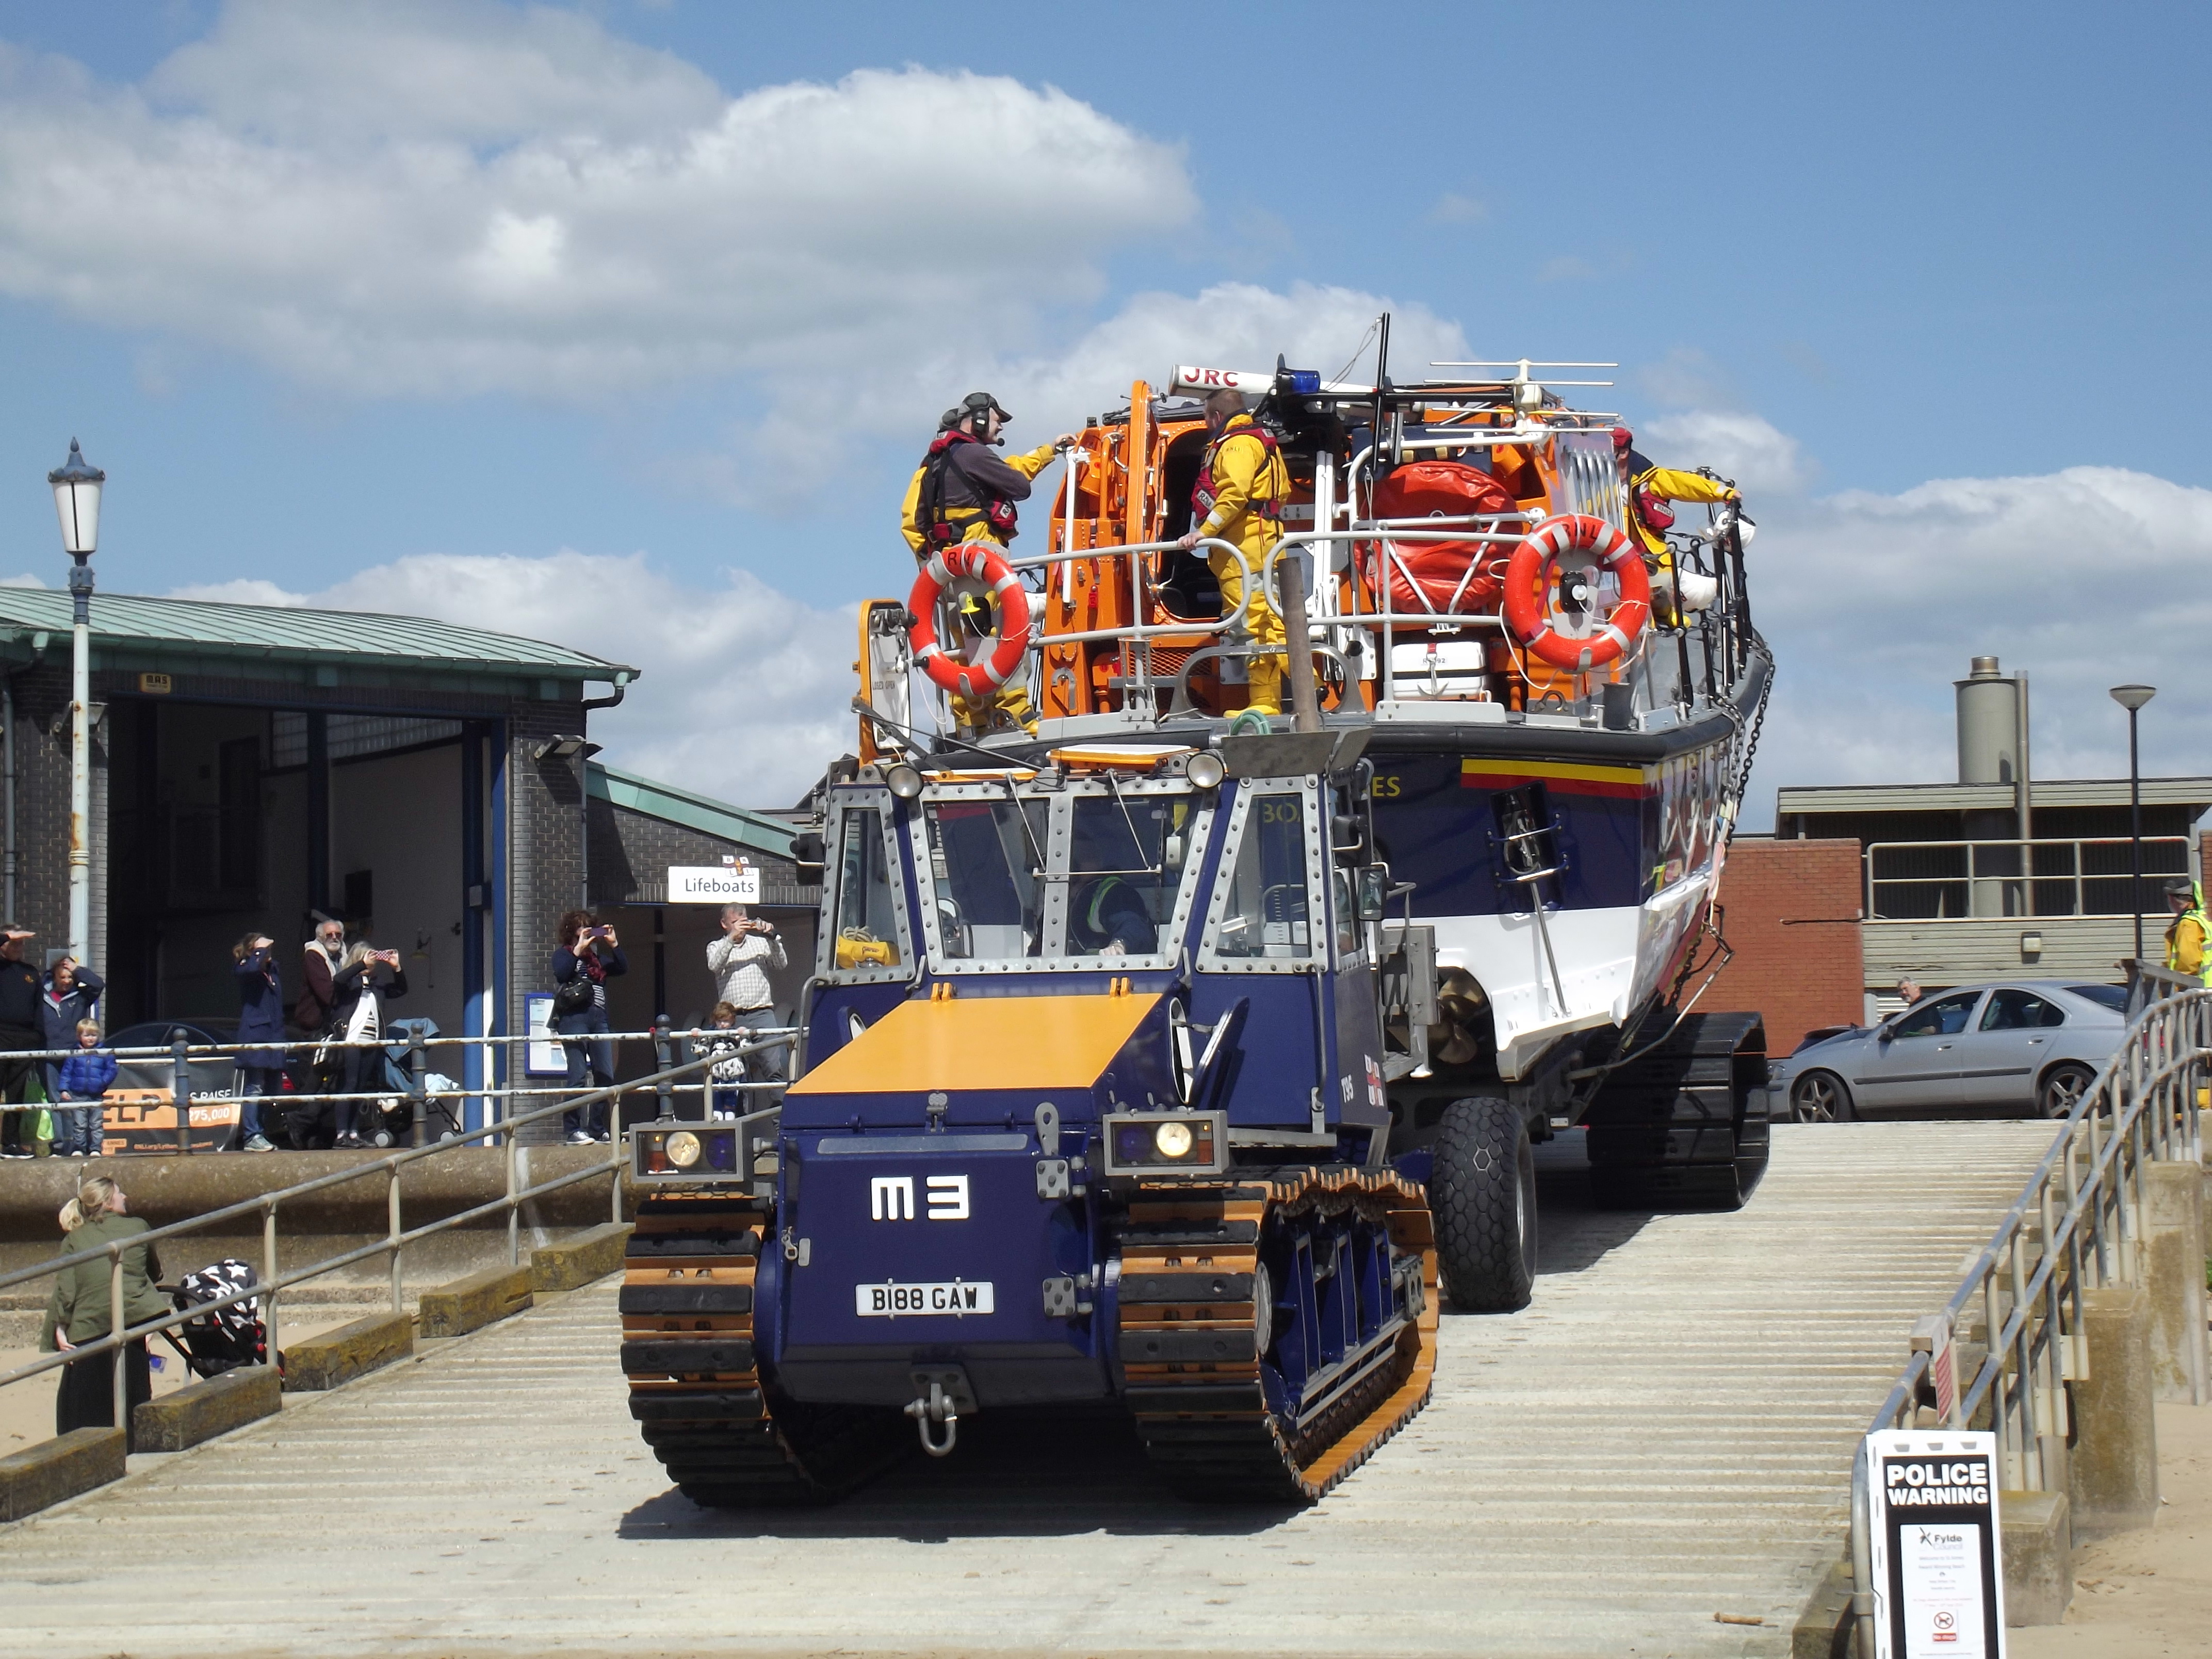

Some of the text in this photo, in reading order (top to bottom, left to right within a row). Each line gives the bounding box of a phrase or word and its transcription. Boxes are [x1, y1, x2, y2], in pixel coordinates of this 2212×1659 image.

[1184, 367, 1239, 387] JRC
[1372, 776, 1401, 797] ES
[686, 877, 754, 892] Lifeboats
[189, 1108, 230, 1121] 275,000
[871, 1287, 978, 1311] B188 GAW
[1886, 1463, 1988, 1487] POLICE
[1887, 1486, 1989, 1506] WARNING
[1934, 1534, 1963, 1543] Fylde
